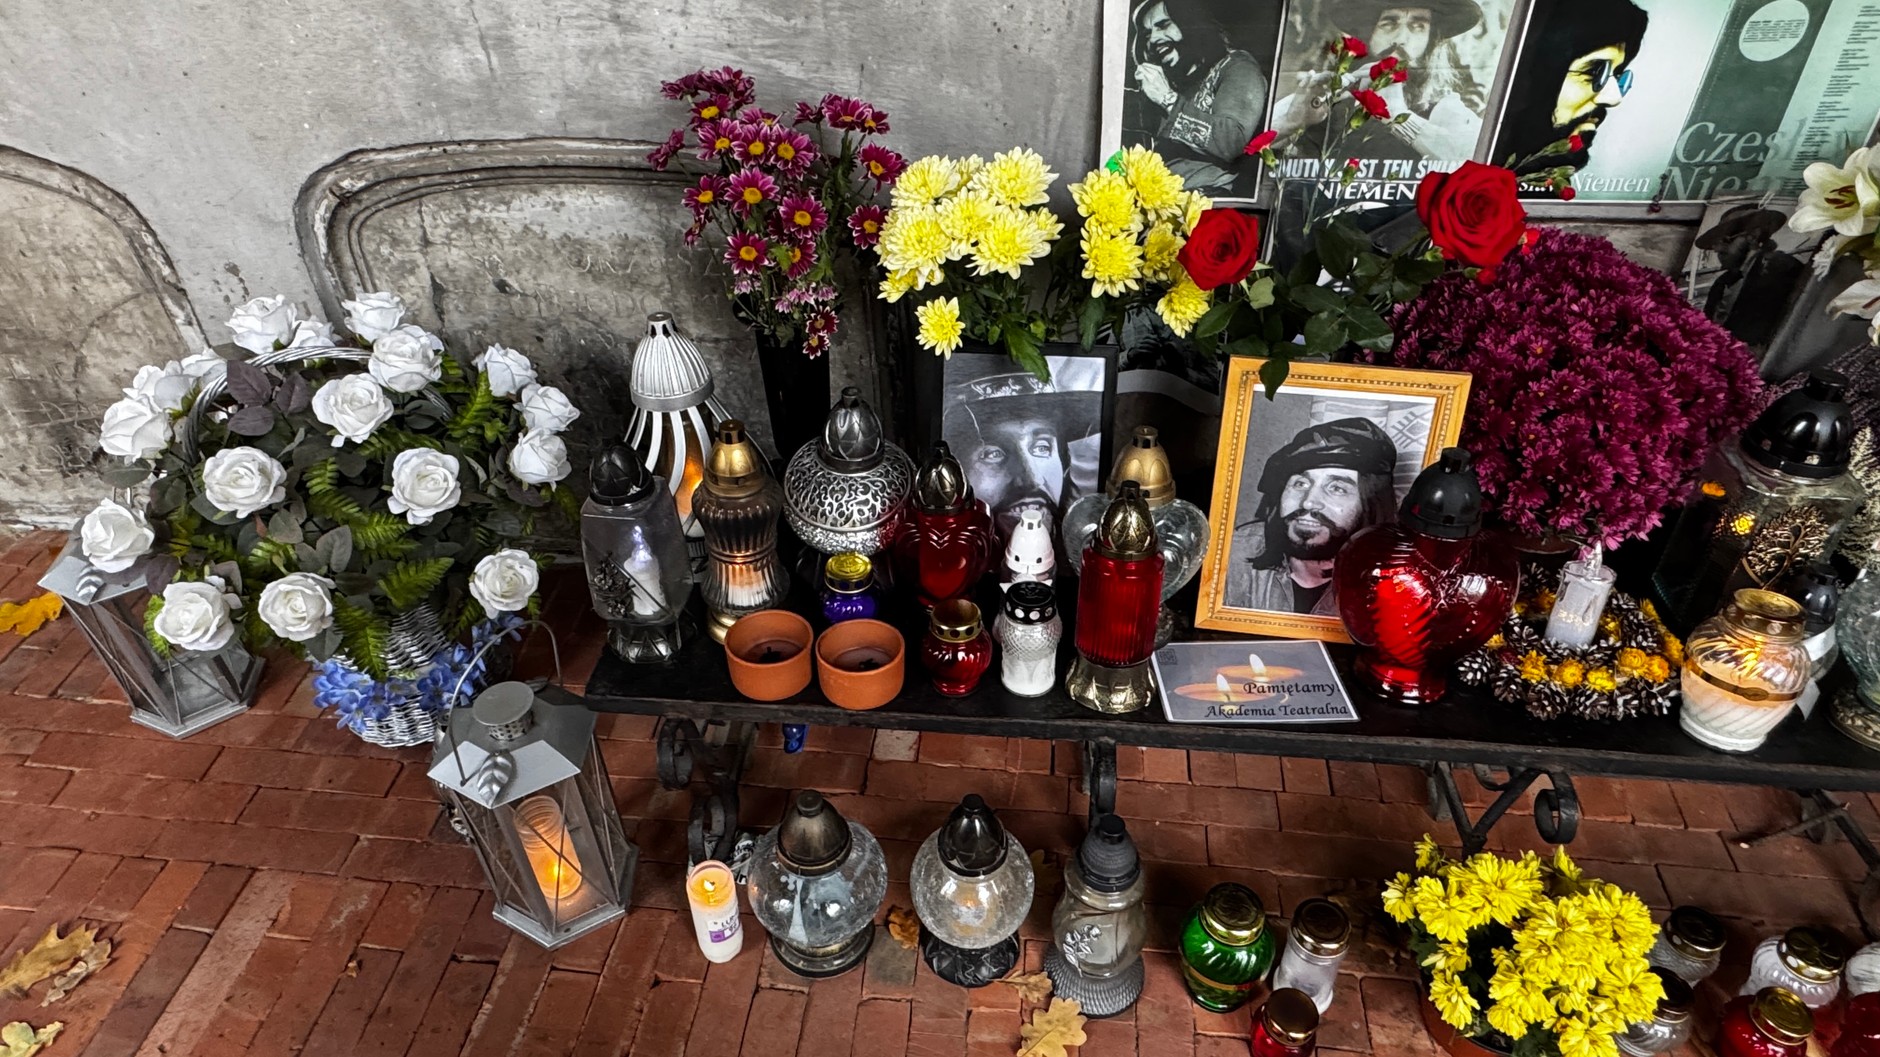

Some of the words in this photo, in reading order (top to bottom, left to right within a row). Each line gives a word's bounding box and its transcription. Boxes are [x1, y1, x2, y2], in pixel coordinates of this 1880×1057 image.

[1382, 159, 1413, 178] TEN
[1318, 182, 1417, 200] NIEMEN
[1573, 172, 1651, 192] Niemen
[1204, 704, 1276, 719] Akademia
[1278, 702, 1348, 717] Teatralna
